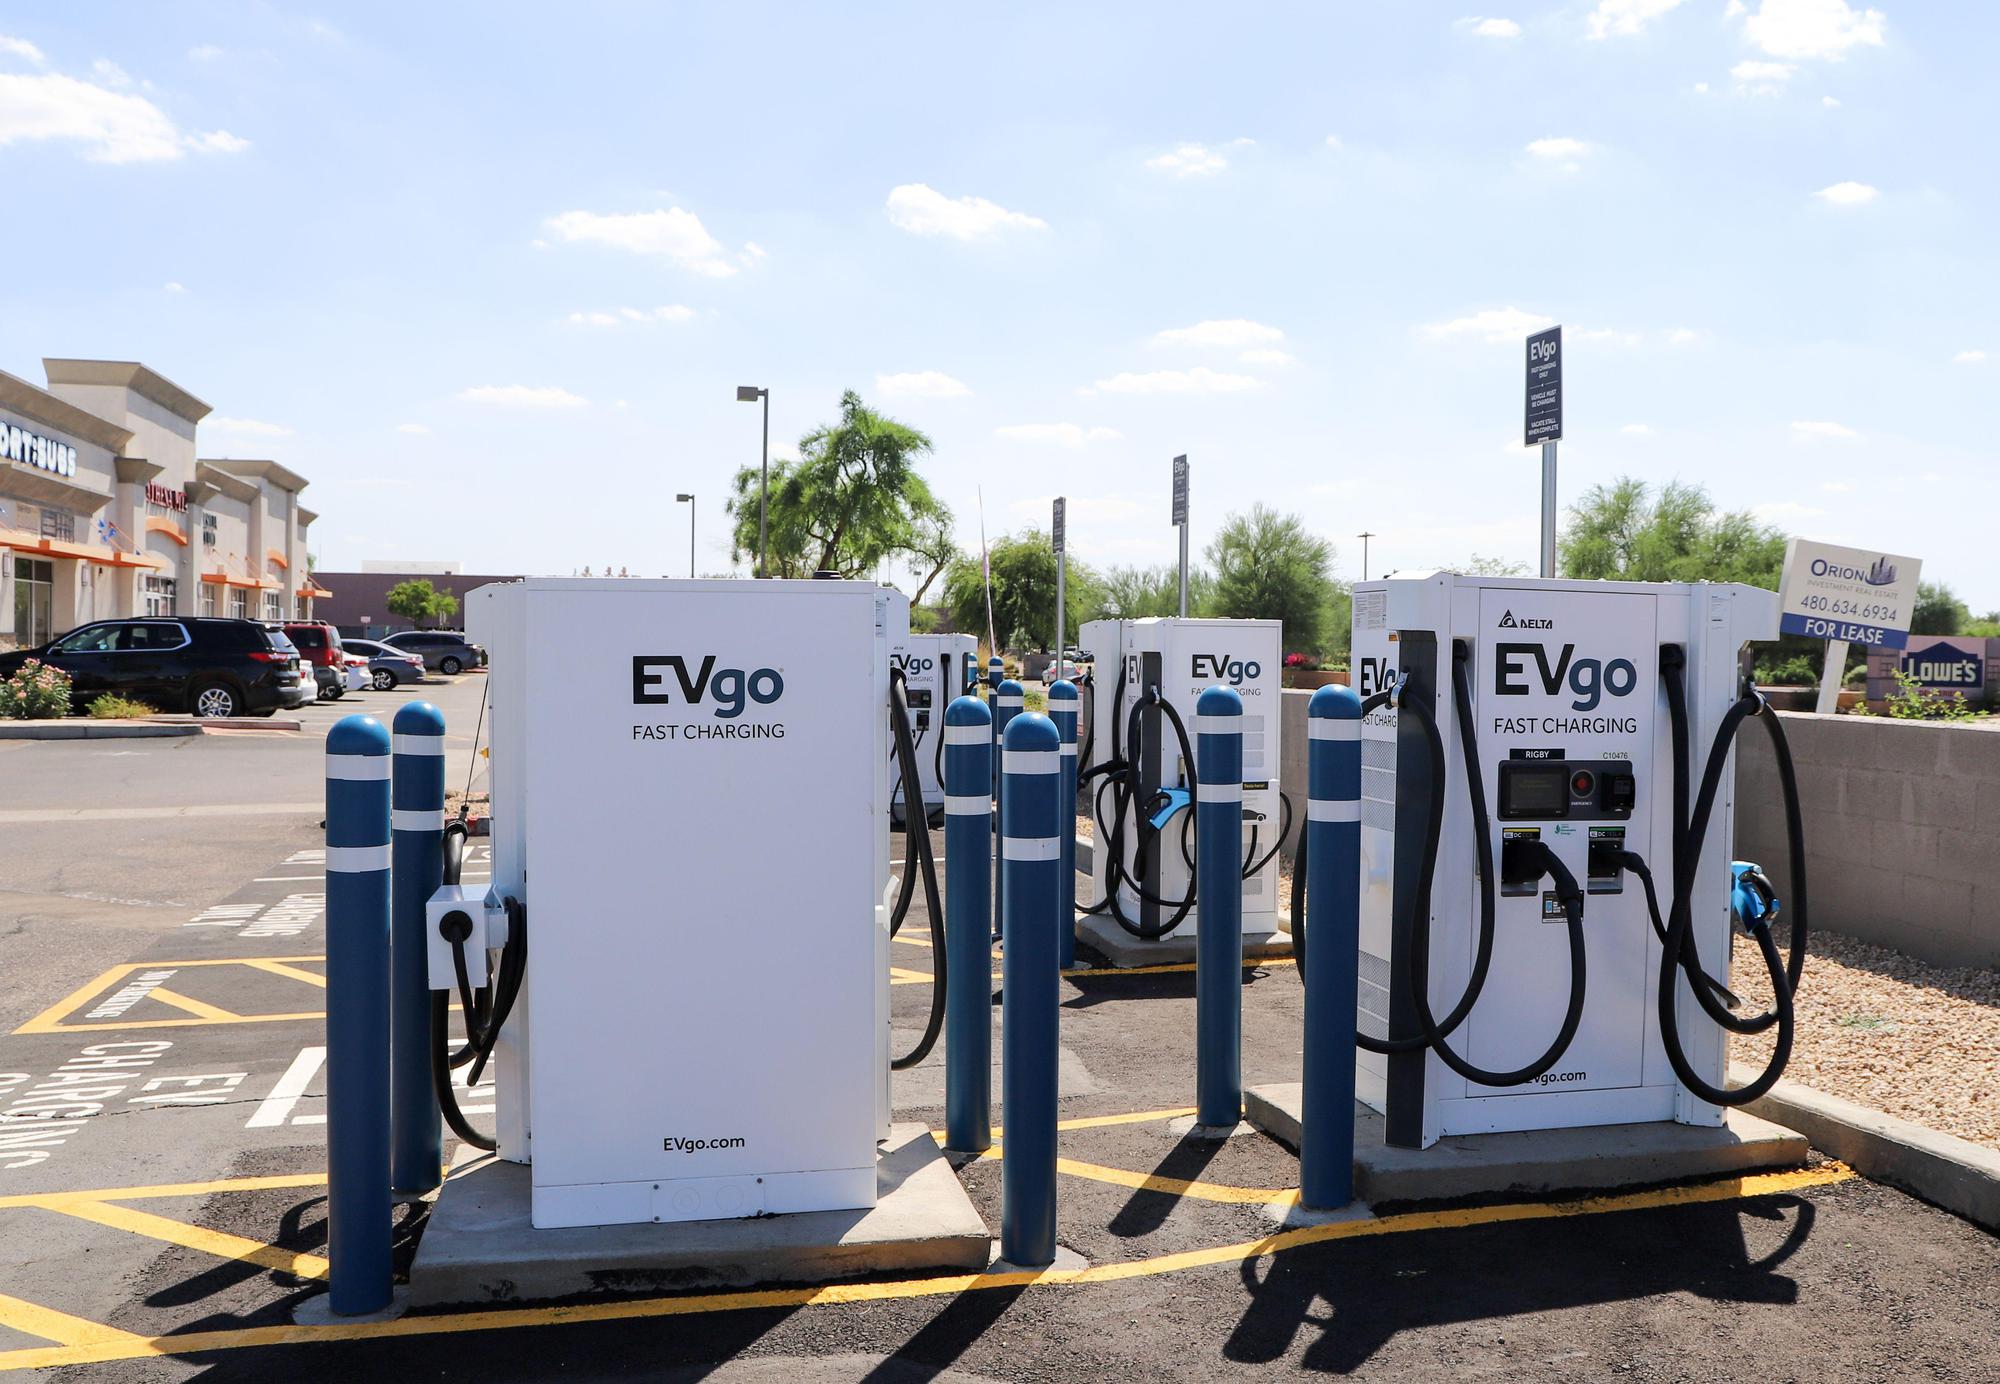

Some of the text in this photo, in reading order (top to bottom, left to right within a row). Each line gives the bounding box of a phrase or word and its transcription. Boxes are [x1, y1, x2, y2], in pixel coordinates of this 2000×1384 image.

[1530, 340, 1556, 361] EVgo
[1807, 580, 1898, 599] INVESTMENT REAL ESTATE
[1801, 595, 1897, 622] 480.634.6934
[1520, 619, 1553, 629] DELTA
[1805, 619, 1884, 644] FOR LEASE
[890, 654, 933, 675] Vgo
[1192, 654, 1261, 685] EVgo
[633, 655, 784, 718] EVgo
[1495, 643, 1638, 712] EVgo
[1363, 713, 1397, 728] AST CHARG
[1494, 718, 1637, 734] FAST CHARGING
[633, 724, 785, 740] FAST CHARGING
[1525, 750, 1550, 758] RIGBY
[1602, 752, 1629, 760] C10476
[182, 903, 266, 926] ONLY
[127, 1072, 249, 1104] EV
[1523, 1071, 1587, 1086] Vgo.com
[663, 1137, 746, 1154] EVgo.com
